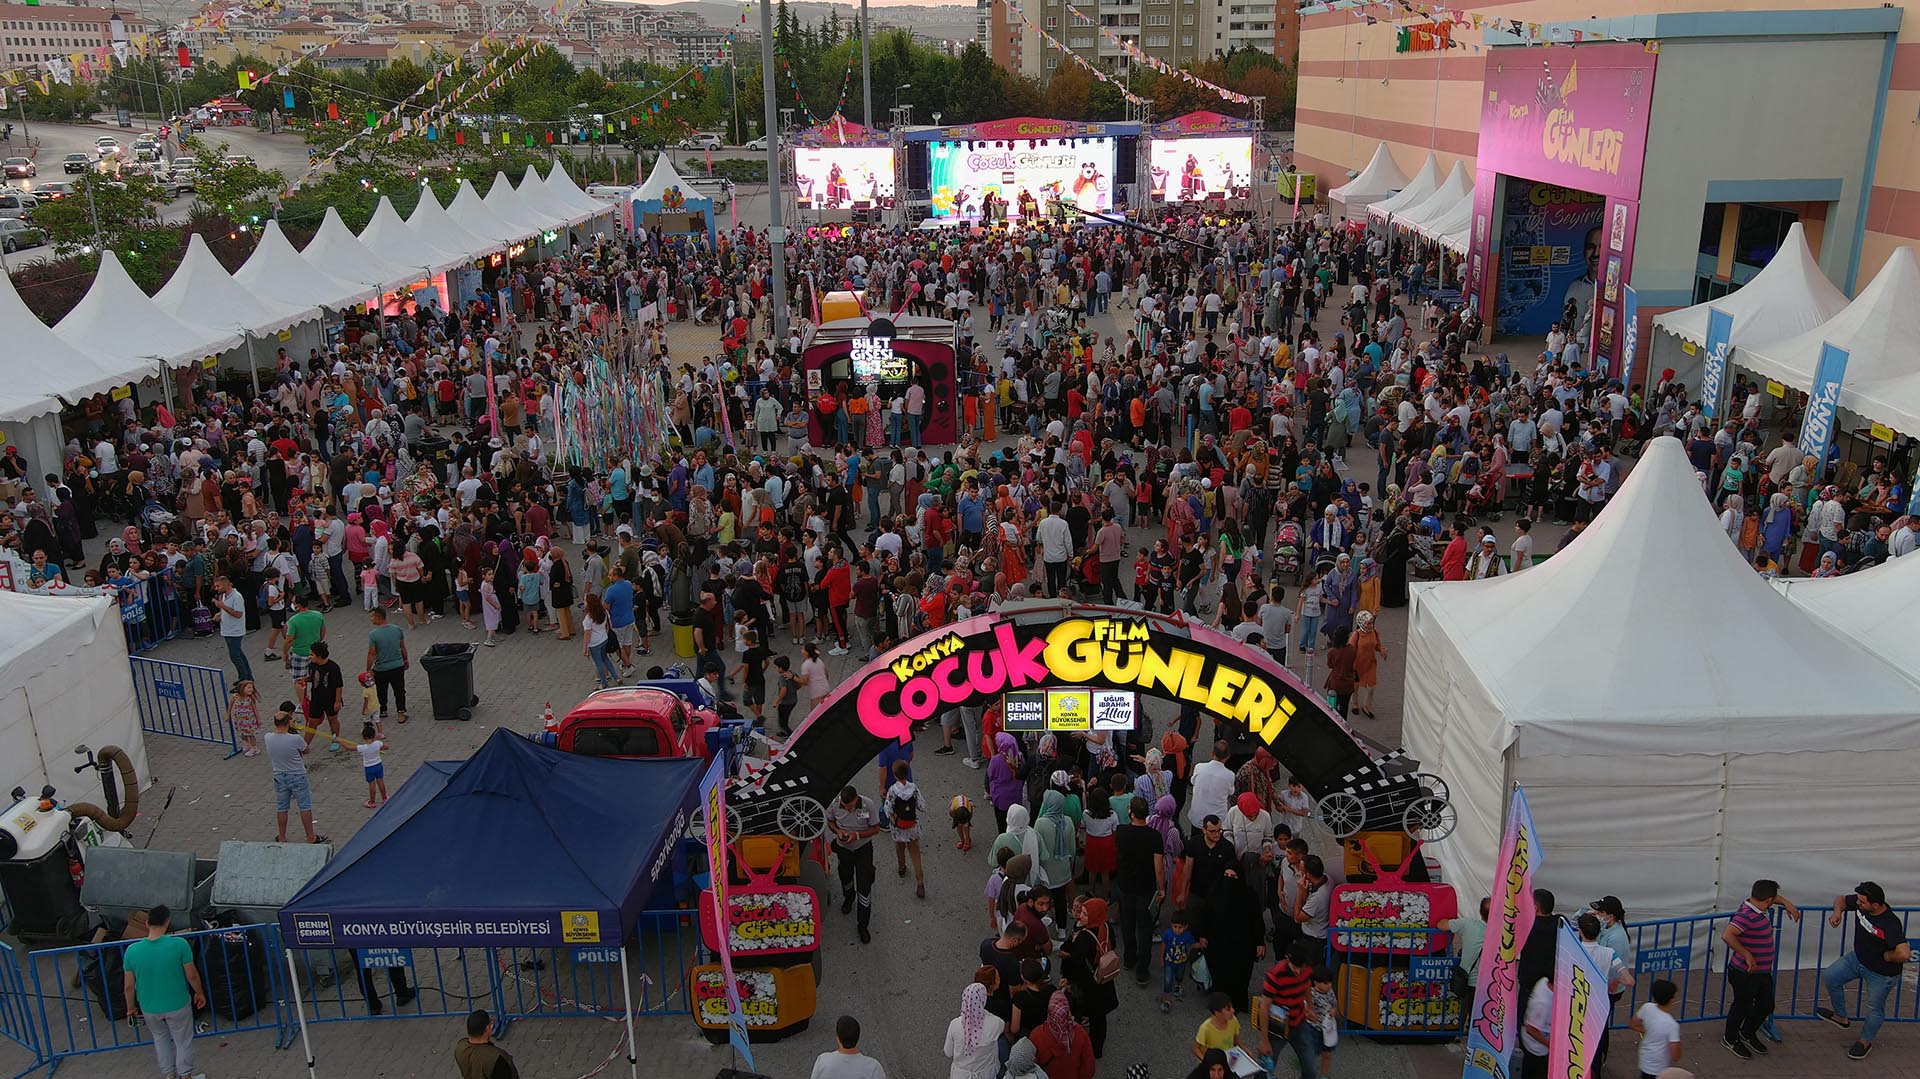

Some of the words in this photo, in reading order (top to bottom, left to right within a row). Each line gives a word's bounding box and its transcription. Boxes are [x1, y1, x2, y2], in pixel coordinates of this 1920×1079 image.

[851, 336, 891, 349] BİLET
[850, 349, 893, 361] GİŞESİ
[1807, 382, 1840, 459] KONYA
[122, 606, 143, 621] POLİS
[1094, 618, 1150, 641] FİLM
[891, 633, 965, 683] KONYA
[1043, 618, 1297, 746] GÜNLERİ
[1007, 701, 1042, 712] BENİM
[1007, 712, 1042, 722] ŞEHRİM
[651, 813, 685, 883] sporkonya
[298, 921, 329, 929] BENİM
[343, 923, 387, 936] KONYA
[389, 920, 472, 938] BÜYÜKŞEHİR
[476, 920, 550, 935] BELEDİYESİ
[300, 929, 330, 937] ŞEHRİM
[578, 949, 619, 962] POLİS
[1648, 950, 1678, 959] KONYA
[364, 955, 407, 968] POLİS
[1641, 958, 1683, 972] POLİS
